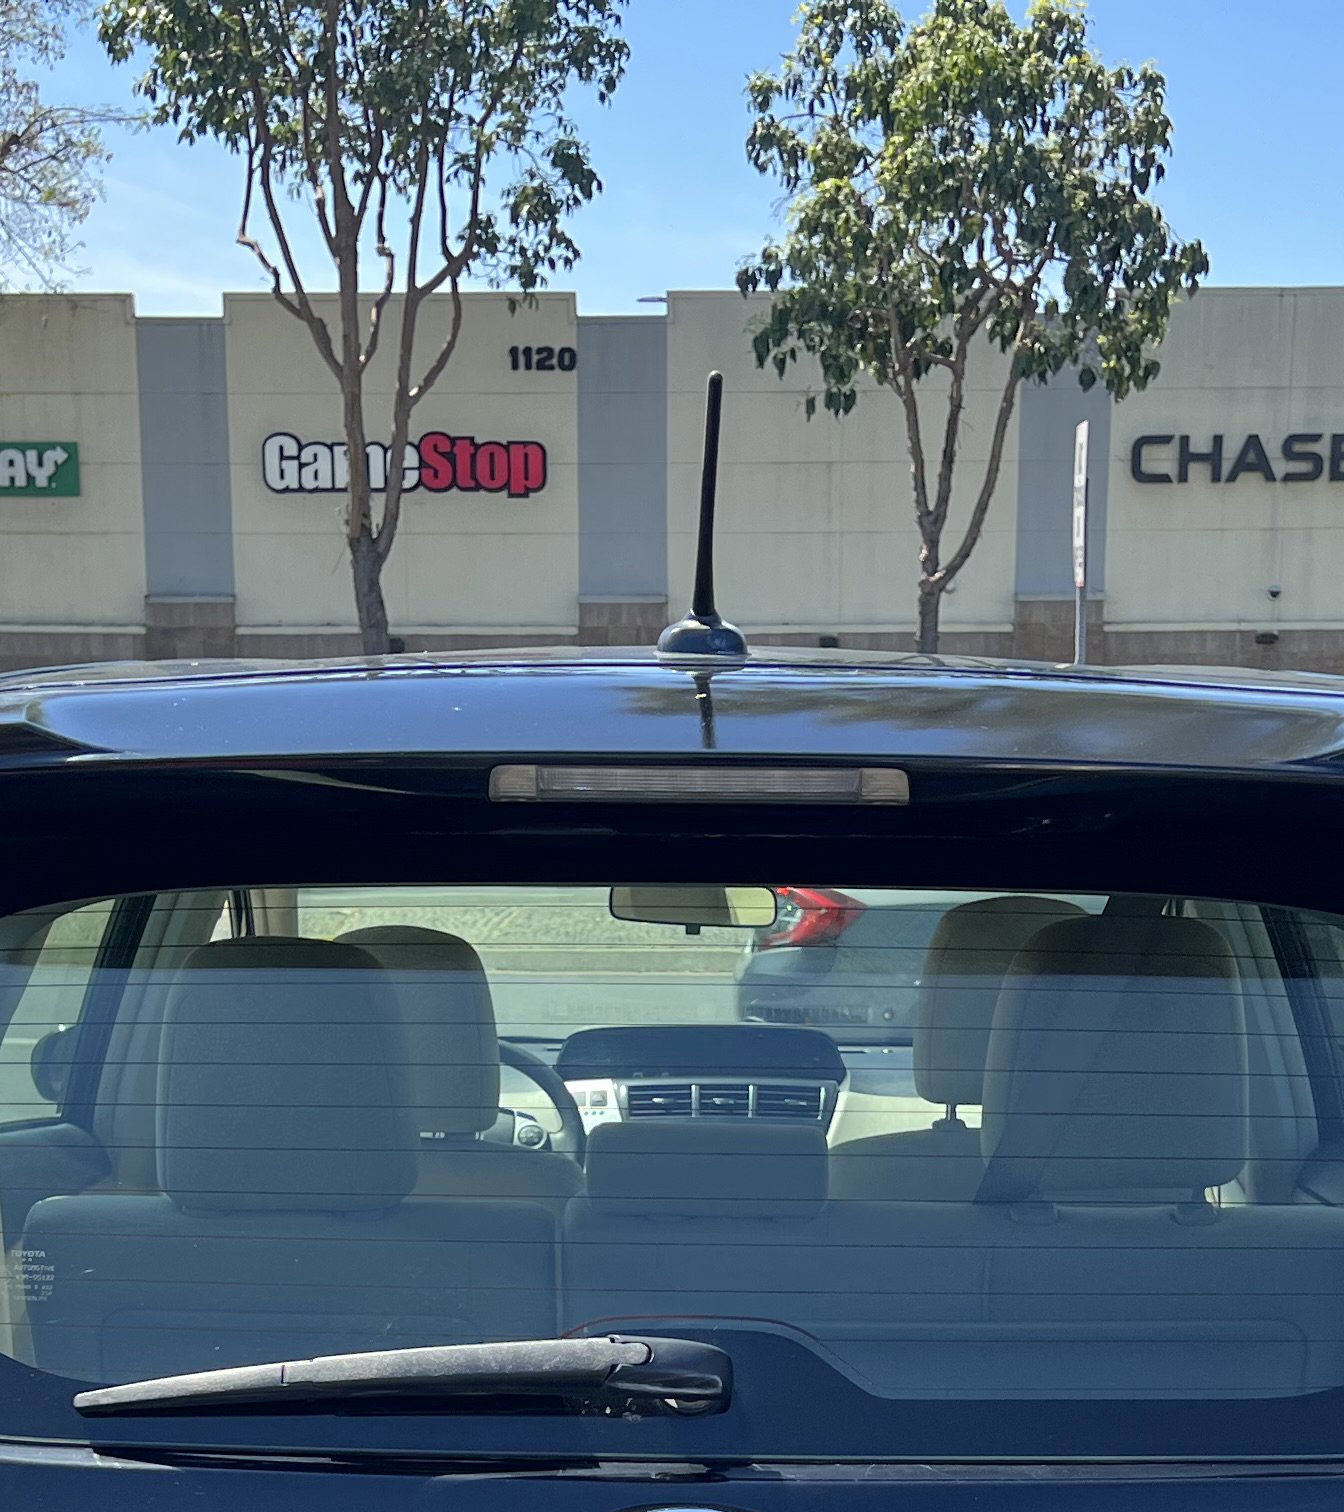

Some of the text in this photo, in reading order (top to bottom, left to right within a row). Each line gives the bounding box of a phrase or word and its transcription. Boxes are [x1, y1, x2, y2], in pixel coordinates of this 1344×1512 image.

[509, 346, 577, 371] 1120
[262, 431, 547, 498] GameStop
[11, 1250, 46, 1258] TOYOTA
